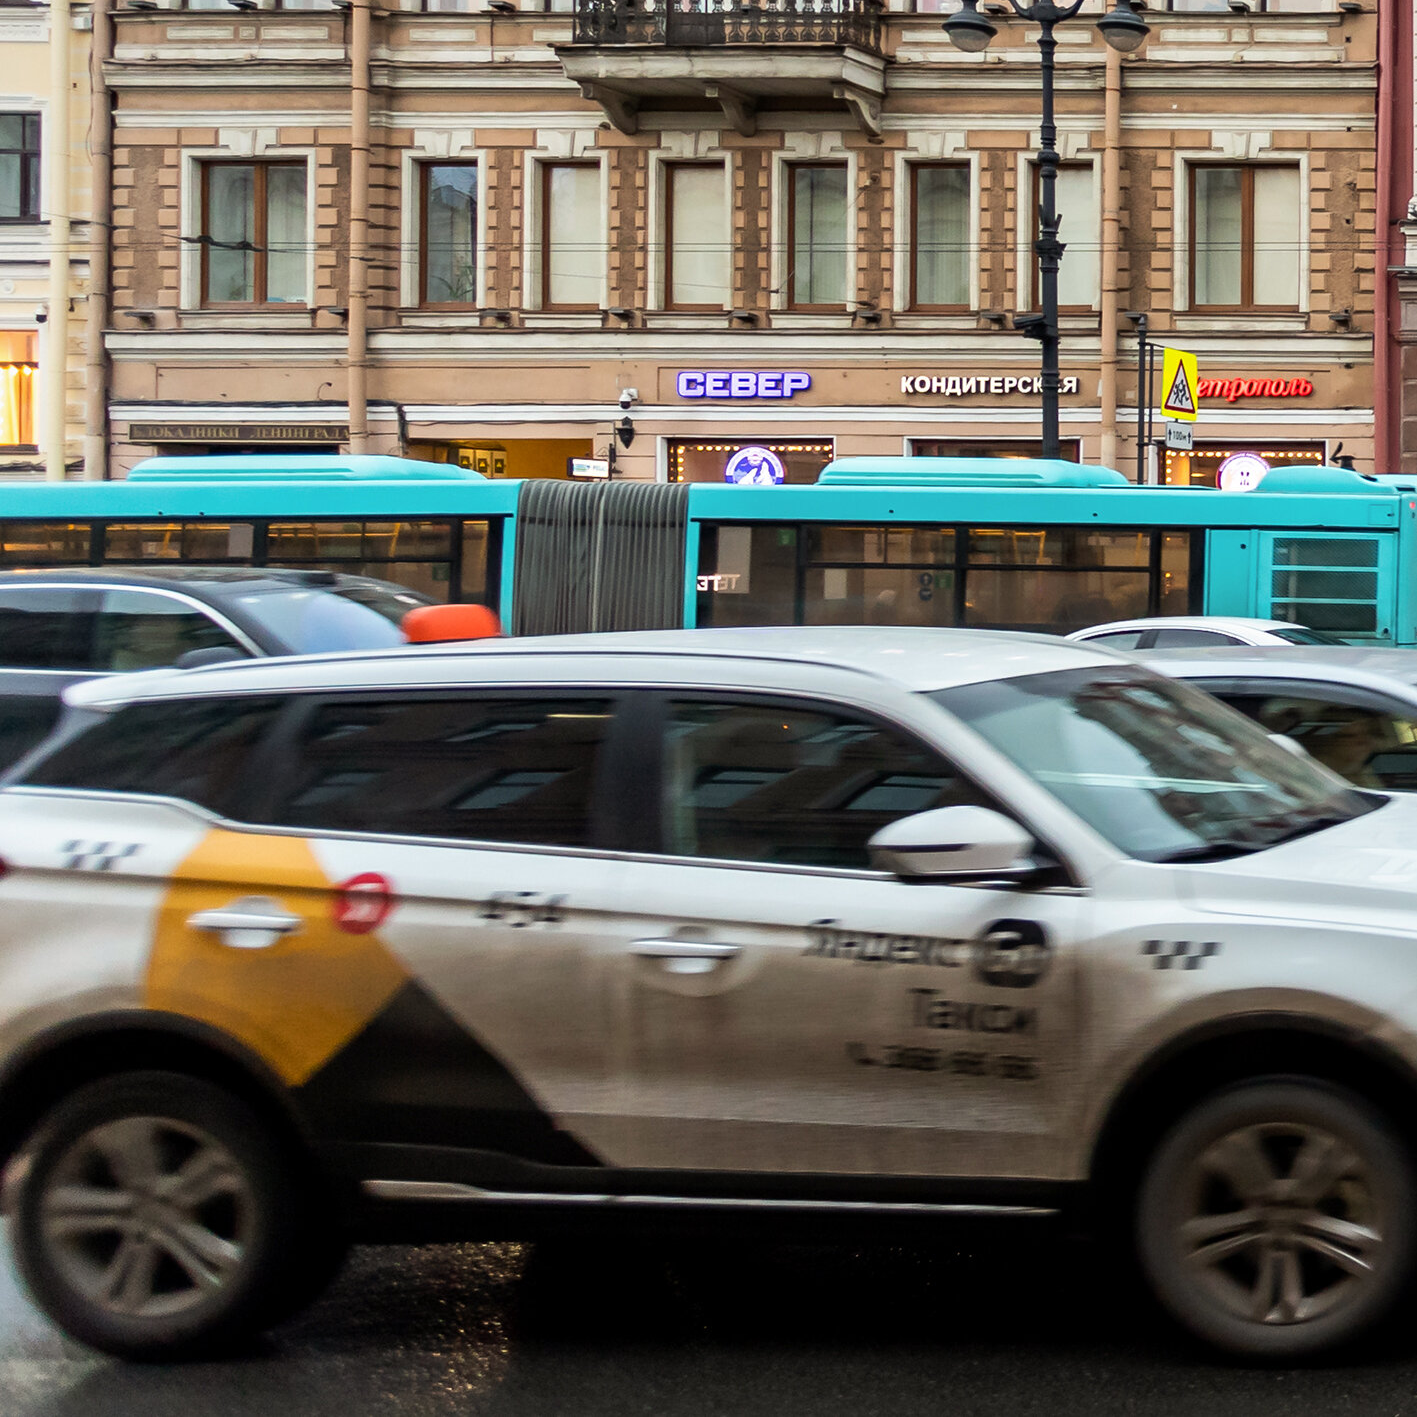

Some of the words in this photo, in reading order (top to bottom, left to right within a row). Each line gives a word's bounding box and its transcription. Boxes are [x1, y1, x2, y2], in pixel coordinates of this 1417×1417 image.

[677, 371, 811, 398] СЕВЕР
[901, 375, 1078, 396] КОНДИТЕРСКЯ
[1196, 377, 1313, 402] етрополь
